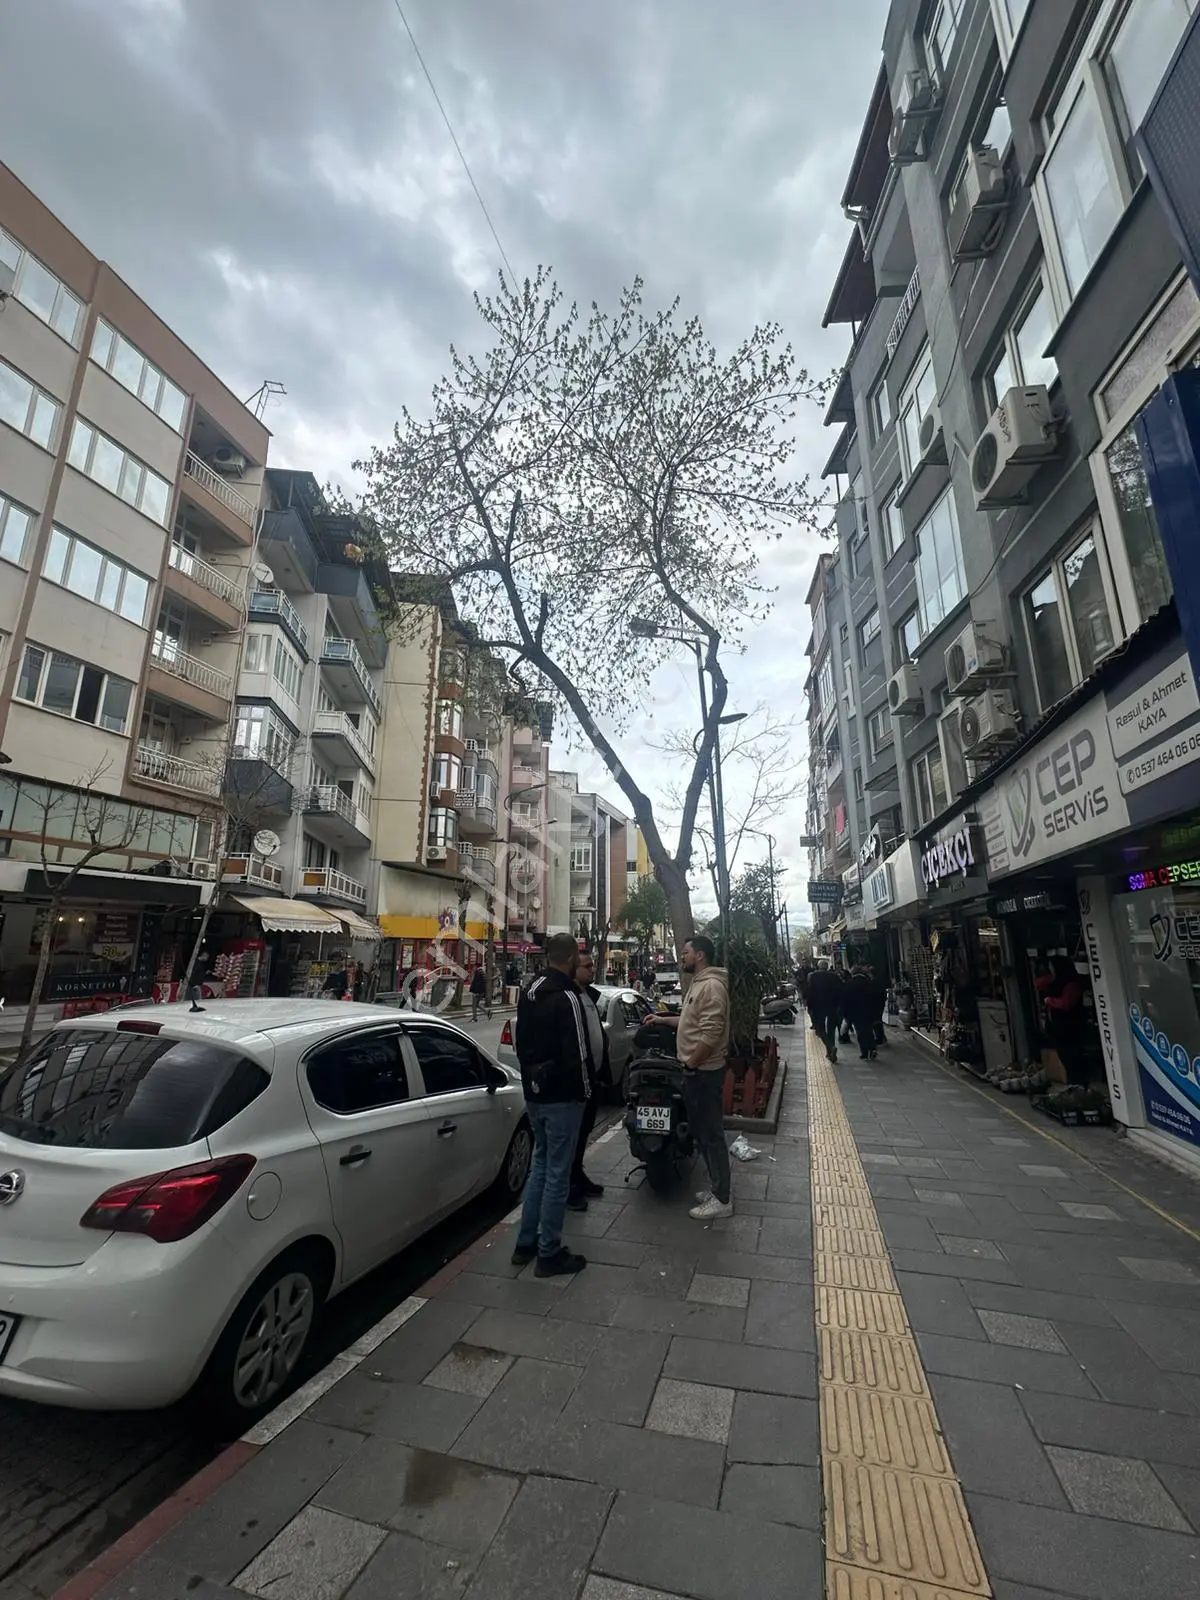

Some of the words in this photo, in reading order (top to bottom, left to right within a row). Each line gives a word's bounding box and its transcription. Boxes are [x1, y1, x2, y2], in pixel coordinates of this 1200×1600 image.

[1115, 702, 1141, 730] Resul
[1142, 697, 1151, 711] &
[1151, 671, 1188, 704] Ahmet
[1137, 707, 1168, 734] KAYA
[1035, 728, 1096, 806] CEP
[1157, 748, 1174, 766] 464
[1086, 922, 1102, 982] CEP
[637, 1107, 650, 1117] 45
[651, 1108, 670, 1118] AVJ
[646, 1119, 665, 1129] 669
